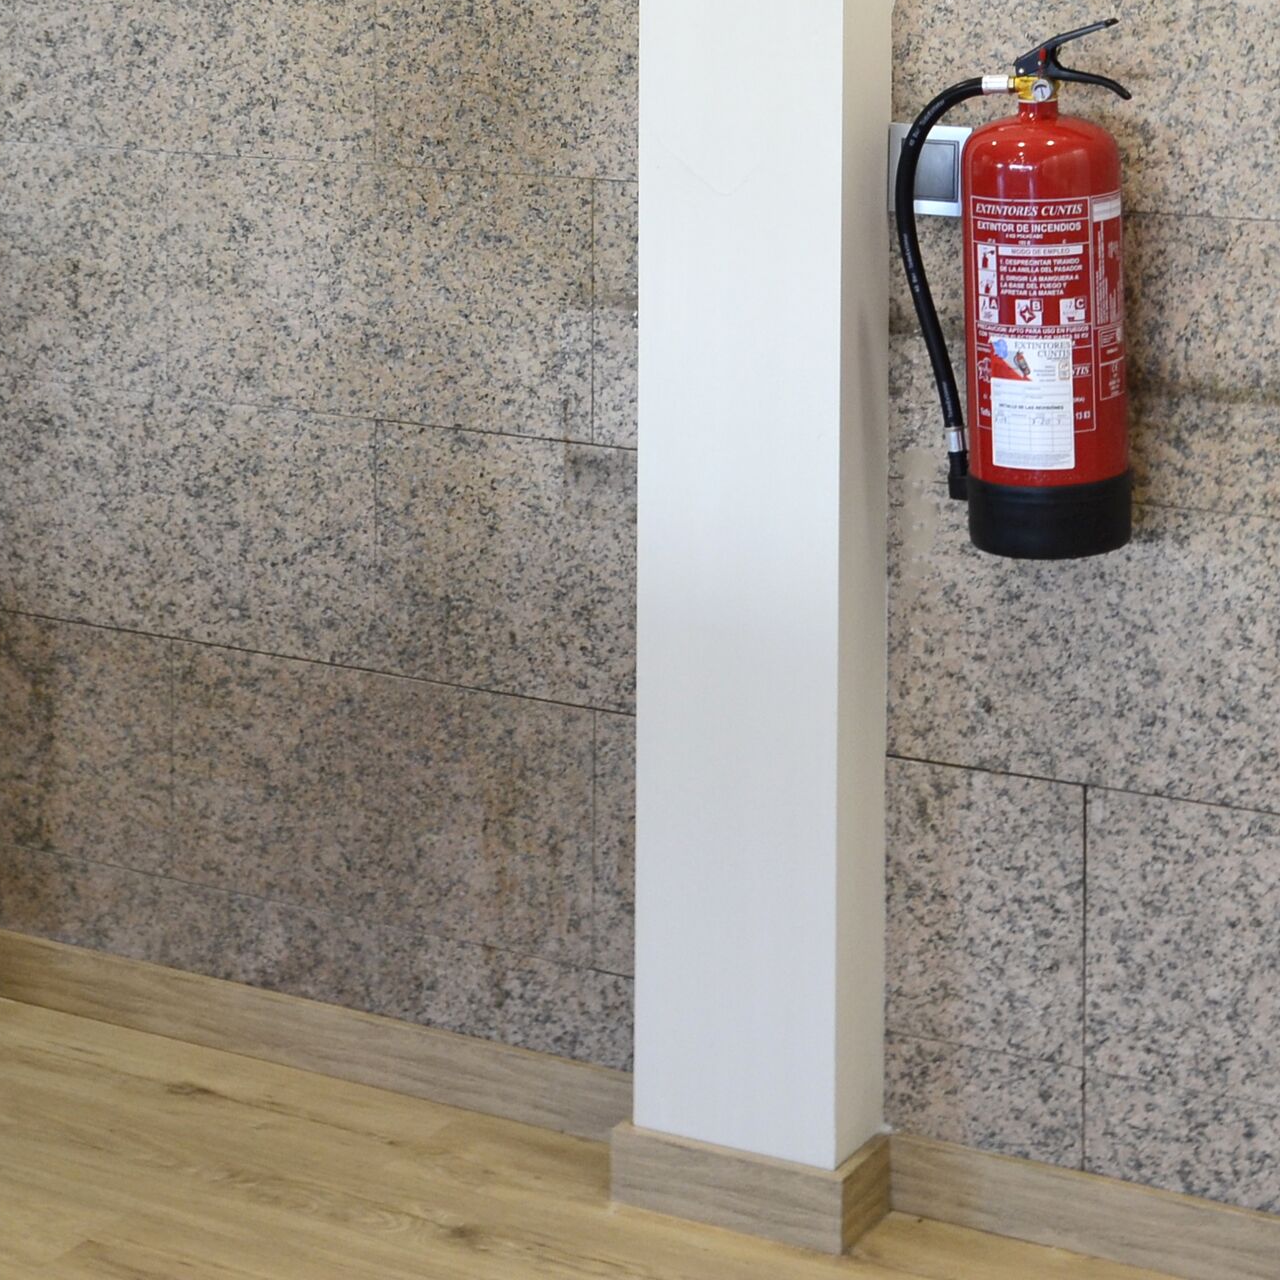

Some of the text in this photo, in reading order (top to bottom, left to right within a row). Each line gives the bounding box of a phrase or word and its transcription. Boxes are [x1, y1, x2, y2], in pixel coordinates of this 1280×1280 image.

[975, 202, 1083, 217] EXTINTORES CUNTIS
[977, 220, 1082, 232] EXTINTOR DE INCENDIOS
[1053, 264, 1082, 272] PASADOR
[990, 300, 998, 308] A
[1032, 302, 1040, 310] B
[1075, 299, 1084, 307] C
[1014, 341, 1071, 349] EXTINTORES
